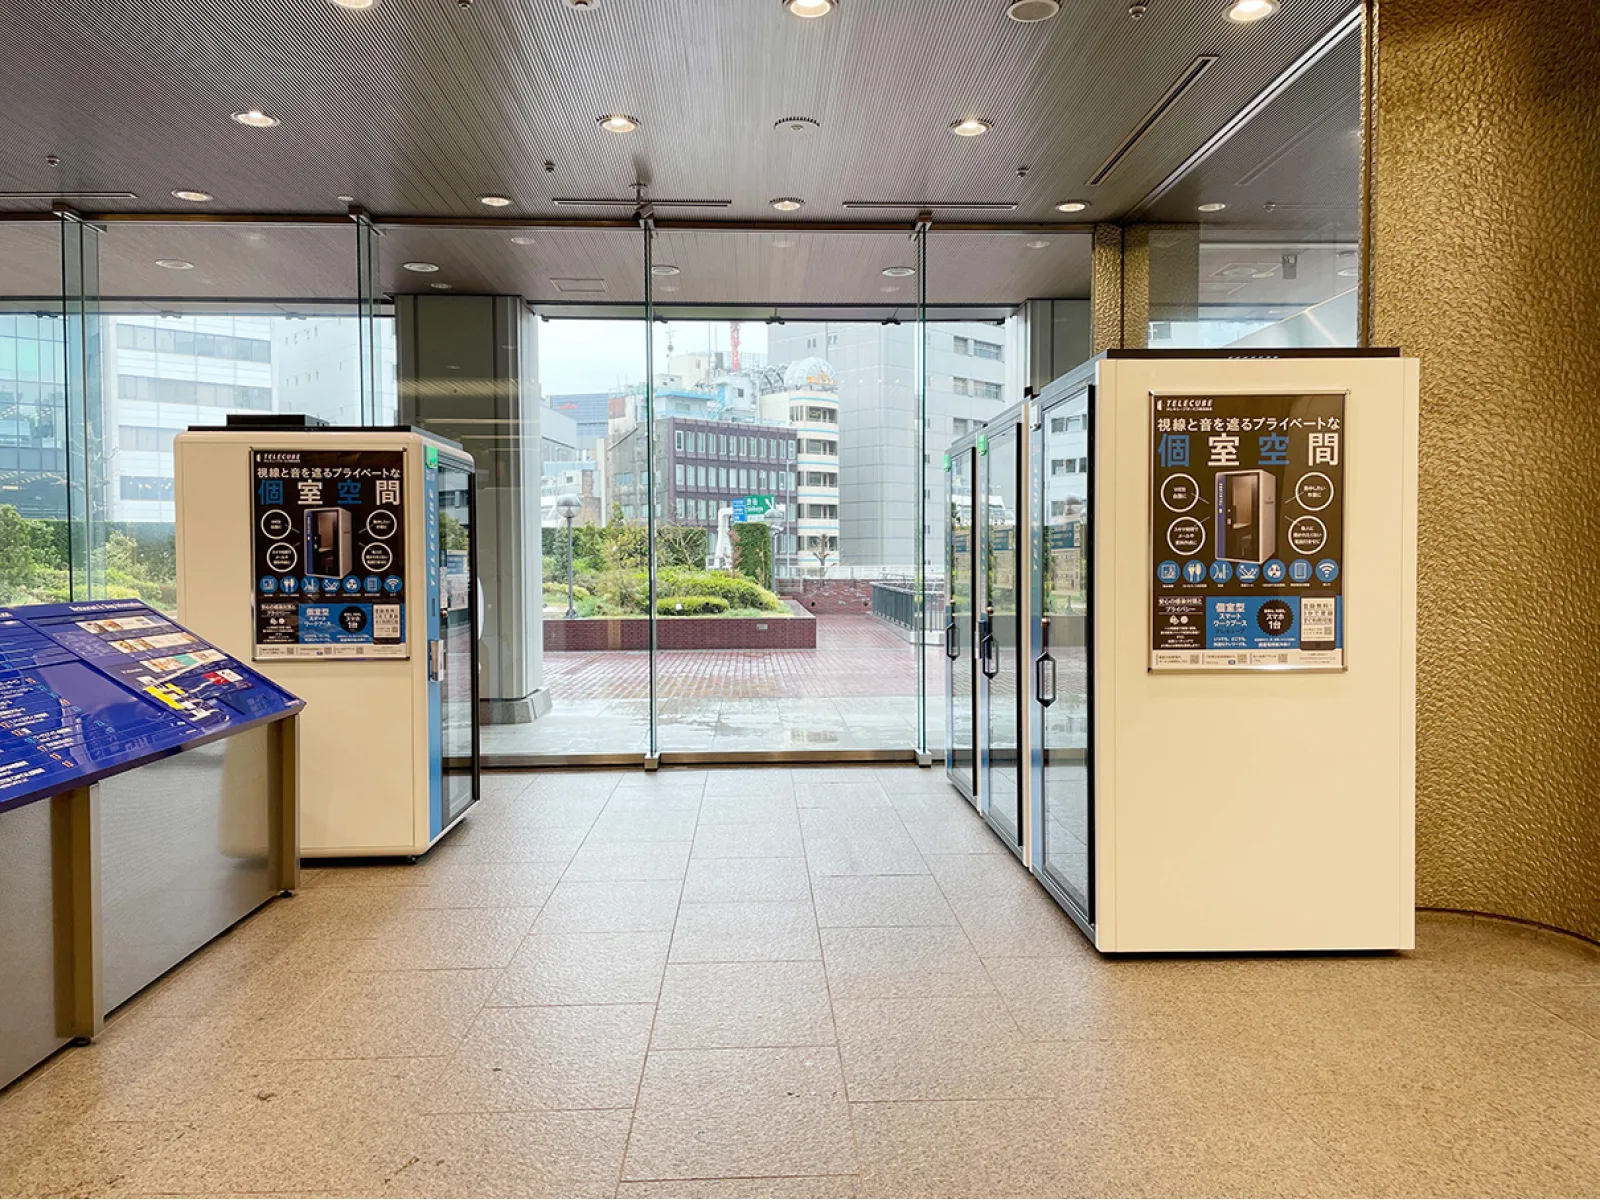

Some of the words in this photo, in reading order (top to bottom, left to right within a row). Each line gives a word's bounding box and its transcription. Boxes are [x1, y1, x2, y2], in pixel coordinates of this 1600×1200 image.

[1166, 399, 1213, 407] TELECUBE
[1157, 417, 1341, 432] 視線と音を遮るプライベートな
[257, 467, 401, 479] 視線と音を遮るプライベートな
[1213, 620, 1248, 628] ワークブース
[1267, 621, 1281, 630] 1台
